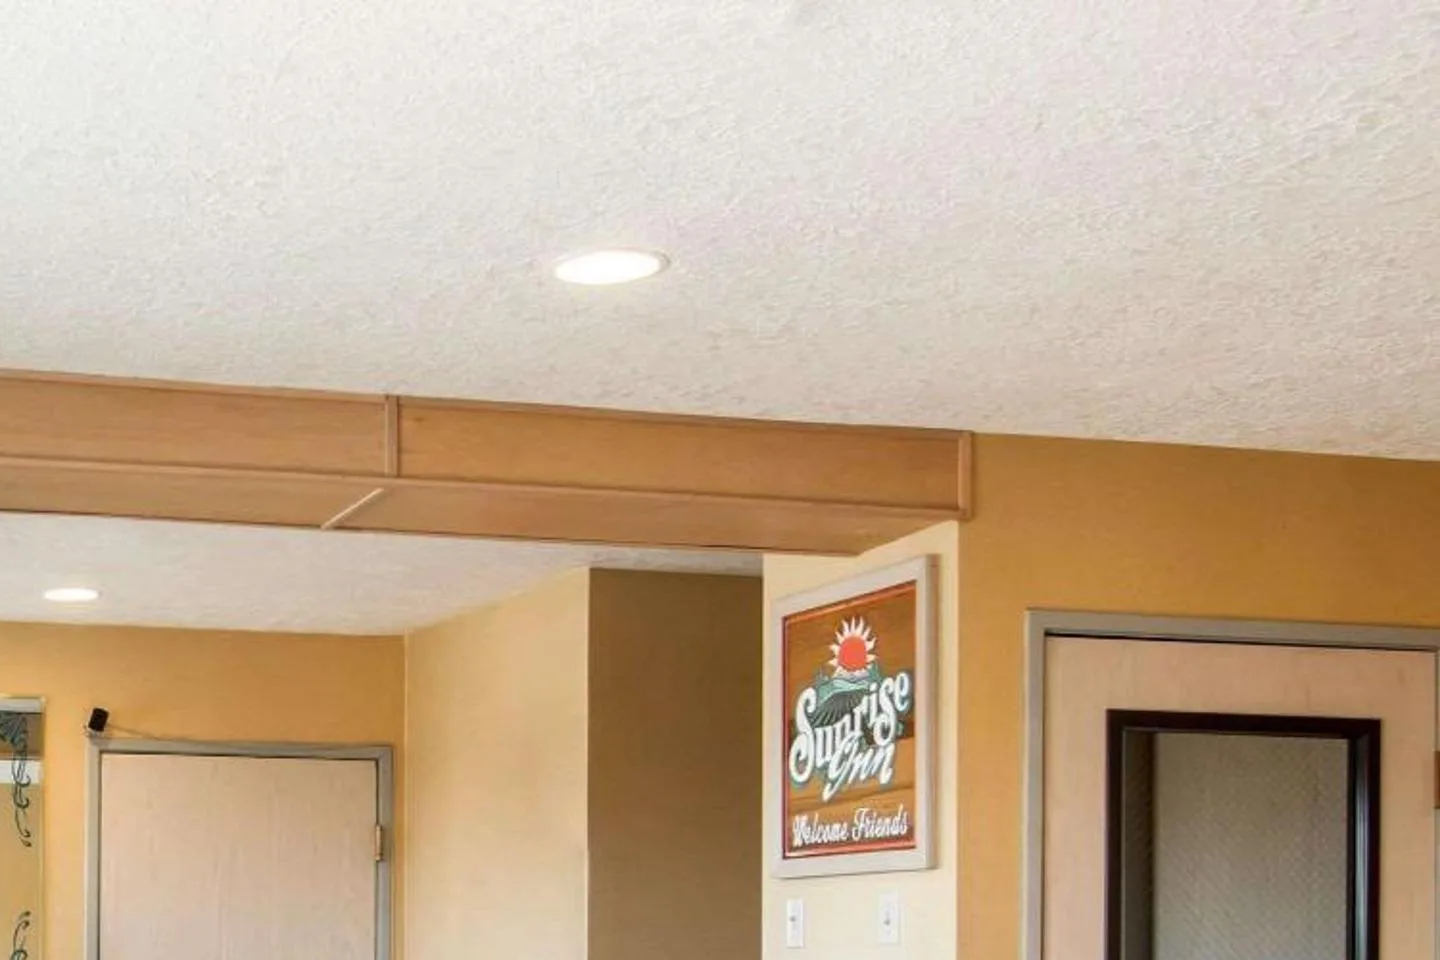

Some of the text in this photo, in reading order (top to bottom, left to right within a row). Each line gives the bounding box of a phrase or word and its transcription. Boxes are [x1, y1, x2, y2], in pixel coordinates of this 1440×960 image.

[788, 671, 911, 784] Sunrise
[821, 736, 895, 802] Inn
[792, 803, 909, 847] Welcome Friends
